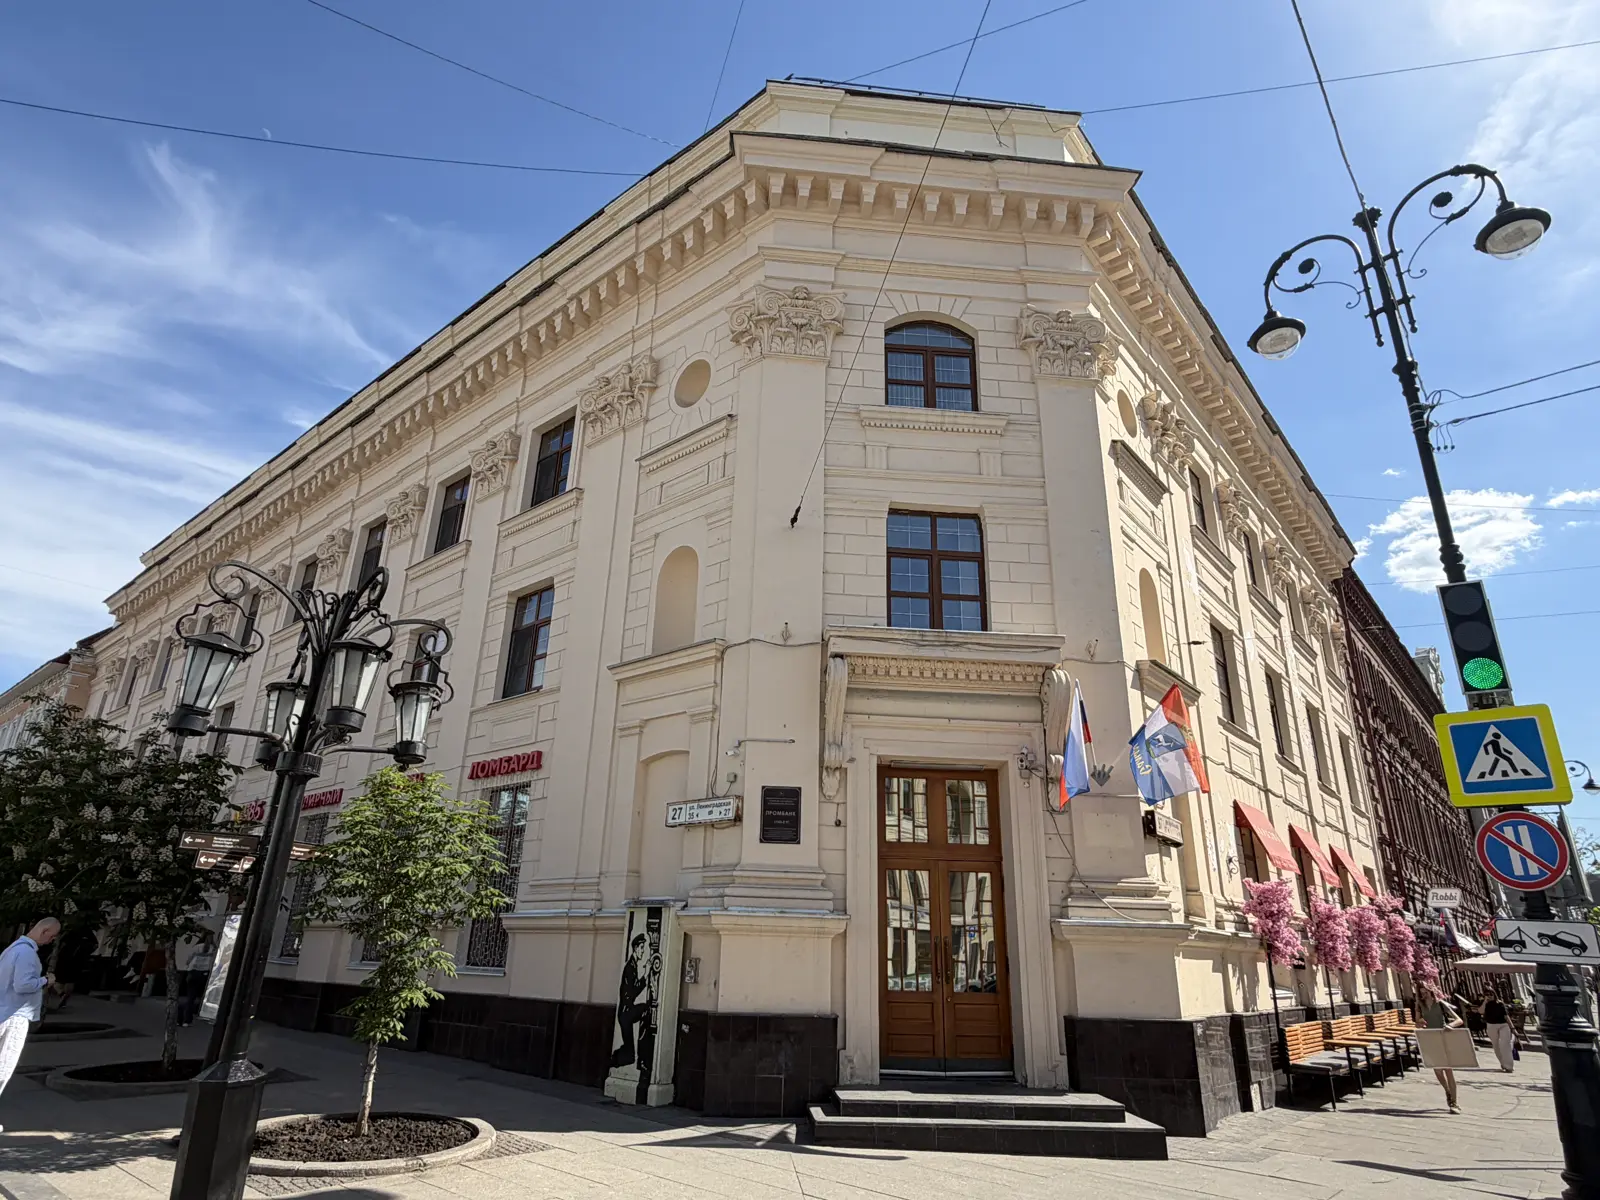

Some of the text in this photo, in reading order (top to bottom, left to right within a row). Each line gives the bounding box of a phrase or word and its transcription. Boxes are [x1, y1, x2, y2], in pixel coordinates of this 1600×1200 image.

[468, 750, 543, 780] ЛОМБАРД
[302, 788, 344, 811] ЛИРНЫЙ
[671, 806, 684, 821] 27
[1431, 891, 1458, 901] Robbi
